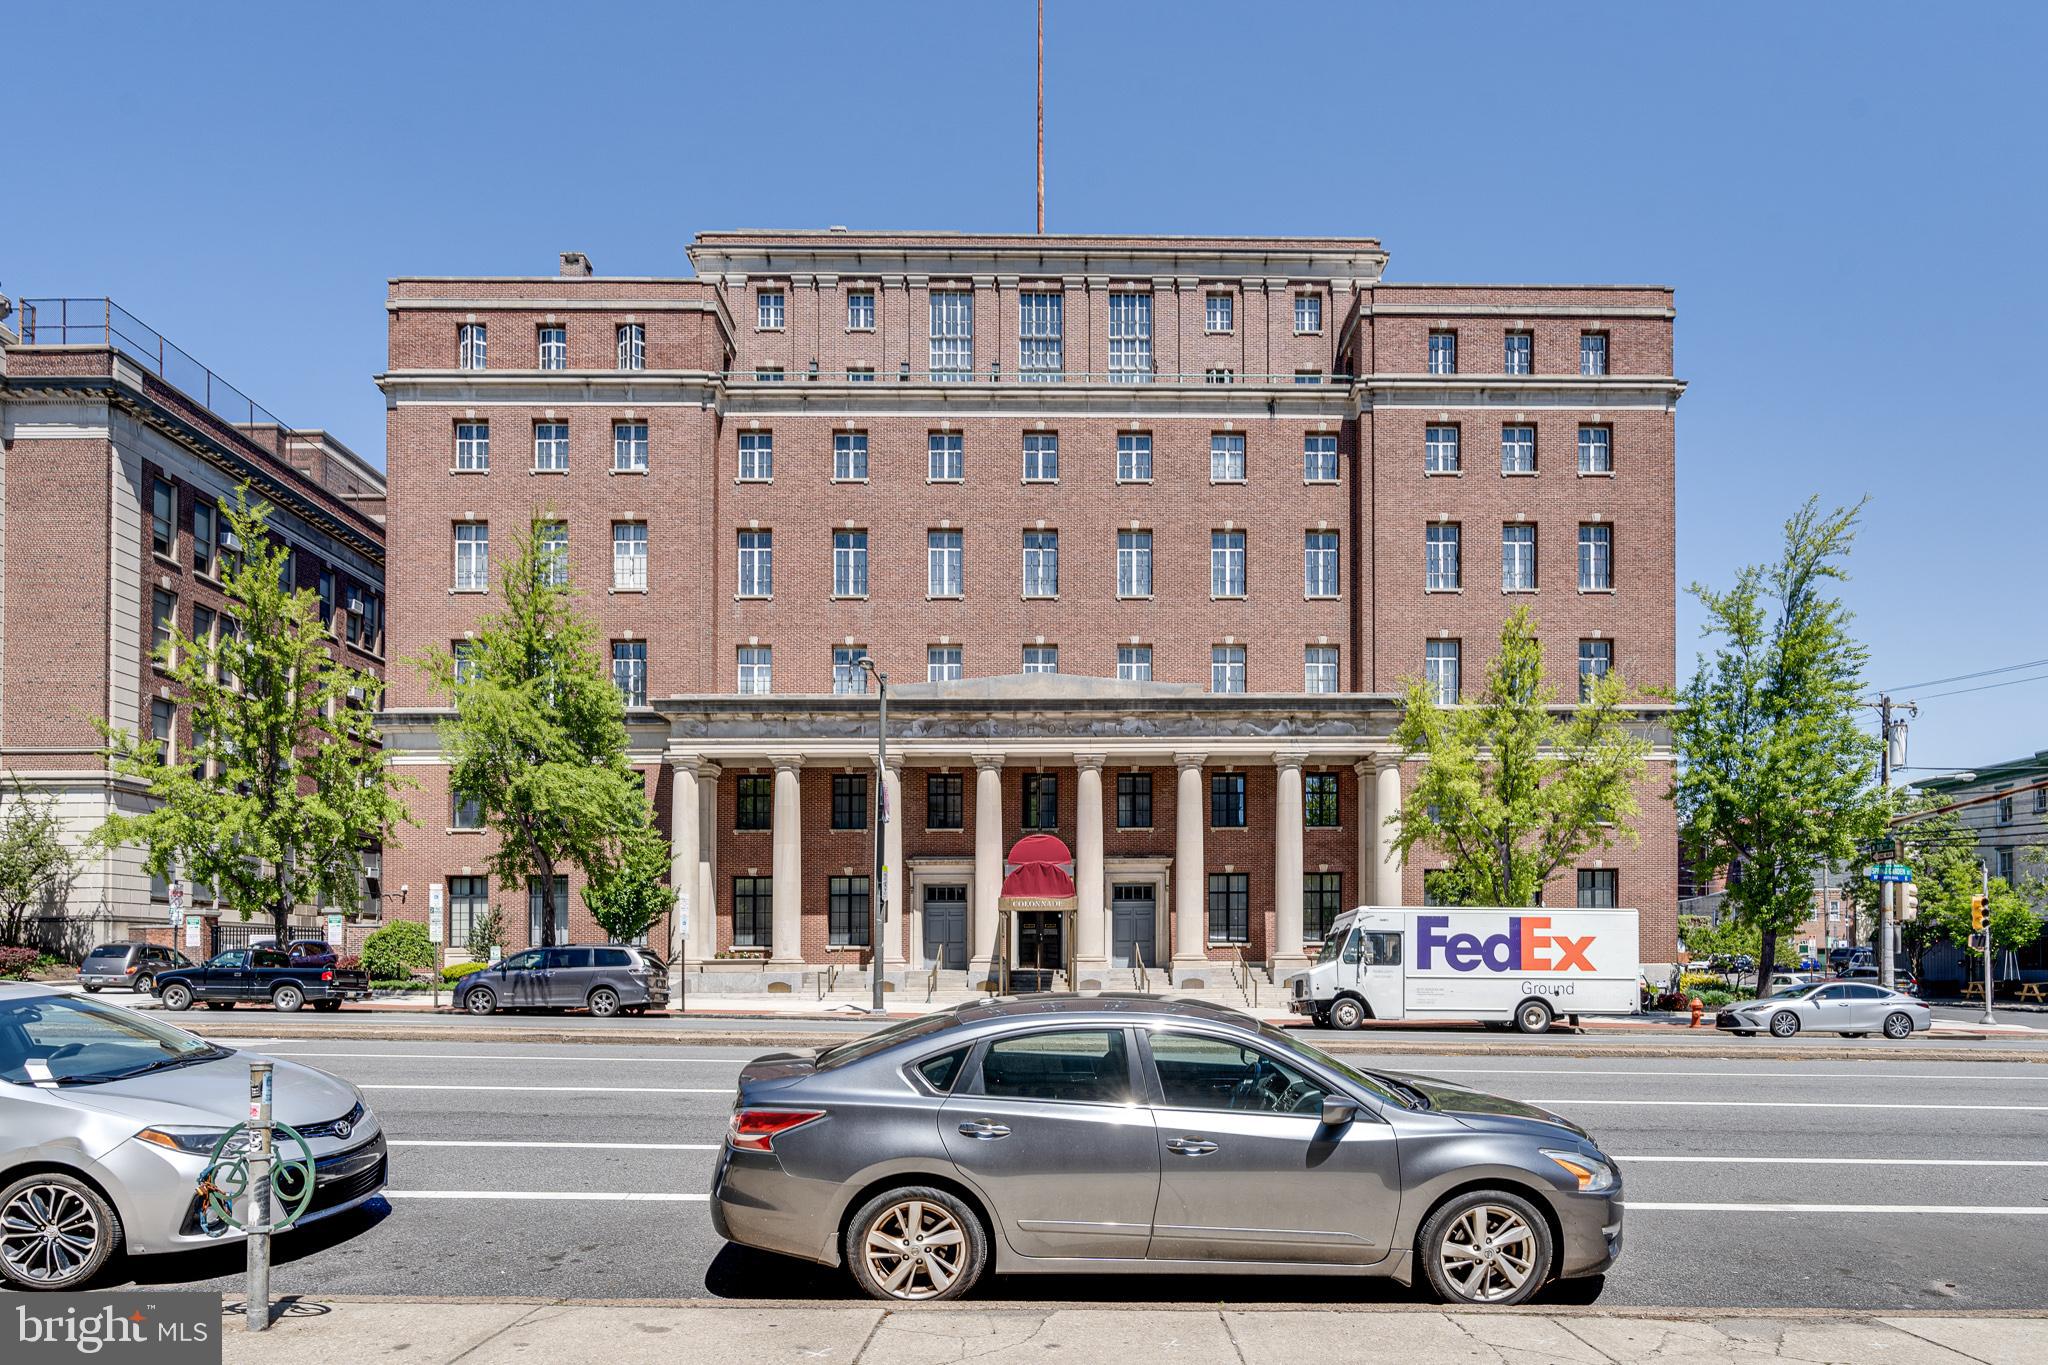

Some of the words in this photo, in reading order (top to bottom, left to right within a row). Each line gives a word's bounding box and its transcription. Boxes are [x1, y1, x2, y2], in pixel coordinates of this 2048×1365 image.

[920, 724, 1000, 734] WILLS
[1027, 724, 1161, 734] HOSITAL
[1417, 916, 1597, 972] FedEx
[1521, 981, 1575, 995] Ground
